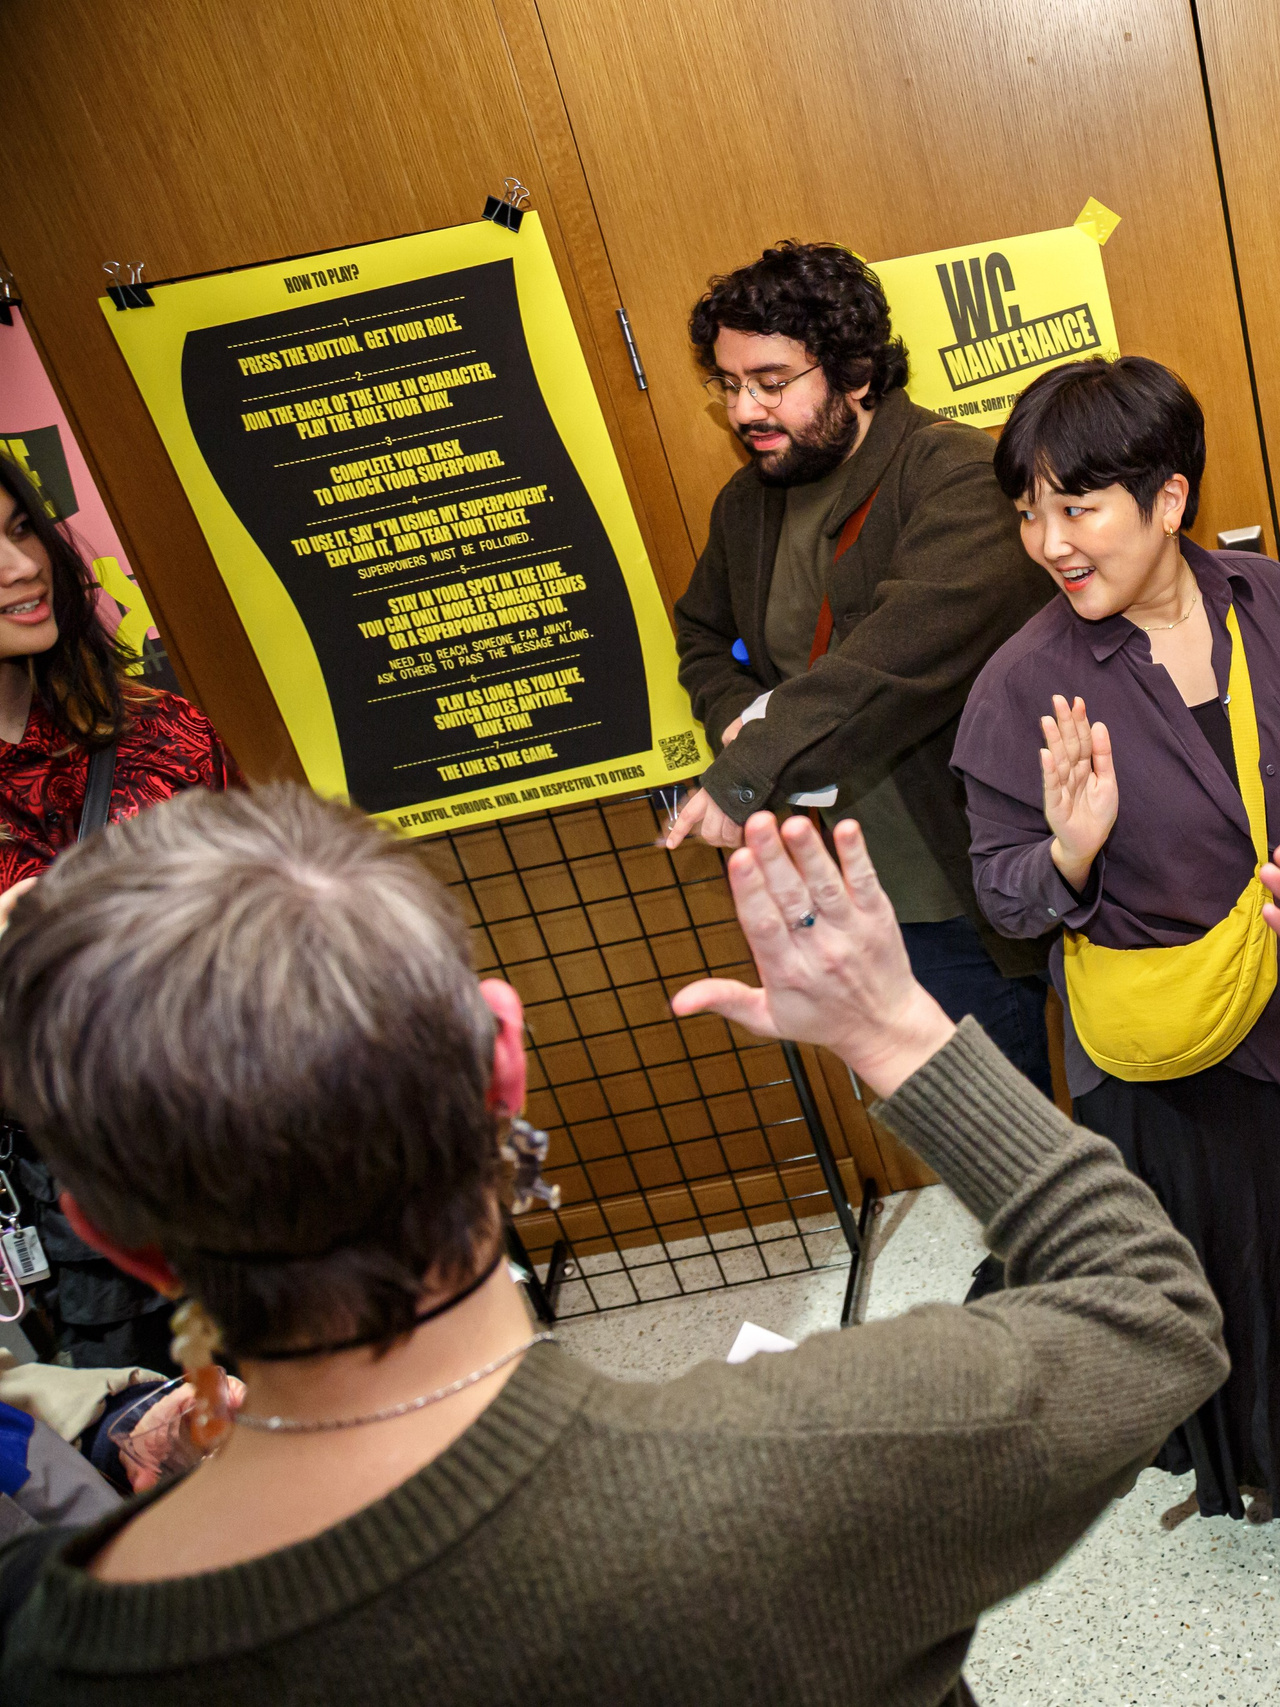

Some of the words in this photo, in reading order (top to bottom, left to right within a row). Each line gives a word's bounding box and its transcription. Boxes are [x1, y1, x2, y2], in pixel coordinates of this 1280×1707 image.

[283, 273, 313, 294] HOW
[310, 270, 328, 288] TO
[326, 263, 360, 285] PLAY?
[935, 252, 1022, 344] WC
[237, 351, 283, 376] PRESS
[278, 346, 309, 368] THE
[304, 334, 364, 363] BUTTON.
[363, 327, 390, 350] GET
[387, 320, 427, 344] YOUR
[423, 313, 463, 337] ROLE.
[342, 317, 350, 327] 1
[943, 309, 1096, 386] MAINTENANCE
[240, 409, 273, 432] JOIN
[268, 404, 298, 426] THE
[293, 396, 334, 421] BACK
[330, 393, 349, 413] OF
[346, 387, 377, 409] THE
[372, 381, 405, 404] LINE
[400, 377, 420, 397] IN
[417, 361, 497, 394] CHARACTER.
[354, 371, 363, 382] 2
[295, 417, 329, 440] PLAY
[326, 411, 356, 433] THE
[351, 404, 388, 428] ROLE
[383, 397, 423, 420] YOUR
[418, 389, 454, 413] WAY.
[958, 401, 982, 417] SOON,
[981, 396, 1007, 413] SORRY
[329, 454, 397, 484] COMPLETE
[392, 446, 431, 470] YOUR
[427, 438, 465, 462] TASK
[384, 435, 393, 446] 3
[312, 487, 335, 507] TO
[331, 475, 386, 503] UNLOCK
[380, 468, 420, 491] YOUR
[416, 449, 506, 483] SUPERPOWER.
[411, 495, 419, 505] 4
[290, 537, 312, 556] TO
[308, 532, 337, 553] USE
[333, 529, 353, 548] IT,
[348, 523, 375, 544] SAY
[398, 508, 444, 535] USING
[437, 503, 464, 527] MY
[324, 541, 378, 568] EXPLAIN
[374, 538, 394, 557] IT,
[393, 532, 422, 553] AND
[418, 524, 454, 547] TEAR
[449, 517, 487, 540] YOUR
[483, 507, 531, 532] TICKET.
[357, 554, 428, 580] SUPERPOWERS
[430, 547, 456, 563] MUST
[460, 543, 476, 556] BE
[478, 531, 535, 552] FOLLOWED.
[459, 564, 468, 575] 5
[357, 619, 386, 639] YOU
[383, 613, 413, 634] CAN
[409, 606, 441, 628] ONLY
[439, 598, 478, 621] MOVE
[473, 595, 488, 613] IF
[486, 583, 546, 610] SOMEONE
[542, 573, 587, 598] LEAVES
[387, 593, 419, 615] STAY
[417, 589, 436, 608] IN
[431, 582, 469, 604] YOUR
[465, 574, 499, 597] SPOT
[497, 571, 515, 590] IN
[511, 566, 539, 587] THE
[535, 560, 567, 582] LINE.
[388, 632, 410, 651] OR
[406, 629, 420, 647] A
[416, 611, 499, 644] SUPERPOWER
[495, 602, 540, 626] MOVES
[536, 596, 569, 617] YOU.
[388, 656, 415, 670] NEED
[417, 652, 433, 664] TO
[435, 643, 469, 660] REACH
[471, 632, 516, 652] SOMEONE
[518, 627, 539, 642] FAR
[543, 619, 573, 636] AWAY?
[377, 671, 397, 685] ASK
[399, 662, 438, 680] OTHERS
[439, 658, 455, 671] TO
[457, 652, 485, 667] PASS
[486, 646, 508, 660] THE
[510, 636, 555, 655] MESSAGE
[558, 628, 594, 645] ALONG.
[470, 674, 478, 683] 6
[433, 706, 484, 731] SWITCH
[480, 698, 520, 720] ROLES
[517, 686, 573, 715] ANYTIME,
[435, 692, 467, 713] PLAY
[465, 689, 485, 707] AS
[481, 682, 516, 703] LONG
[513, 678, 532, 696] AS
[528, 672, 557, 692] YOU
[554, 666, 585, 687] LIKE,
[472, 718, 507, 739] HAVE
[502, 711, 533, 732] FUN!
[493, 740, 500, 750] 7
[436, 763, 463, 782] THE
[459, 758, 488, 777] LINE
[484, 755, 501, 772] IS
[496, 750, 523, 769] THE
[520, 743, 559, 764] GAME.
[397, 815, 413, 829] BE
[520, 787, 541, 802] AND
[539, 775, 597, 798] RESPECTFUL
[594, 772, 609, 786] TO
[608, 764, 646, 783] OTHERS
